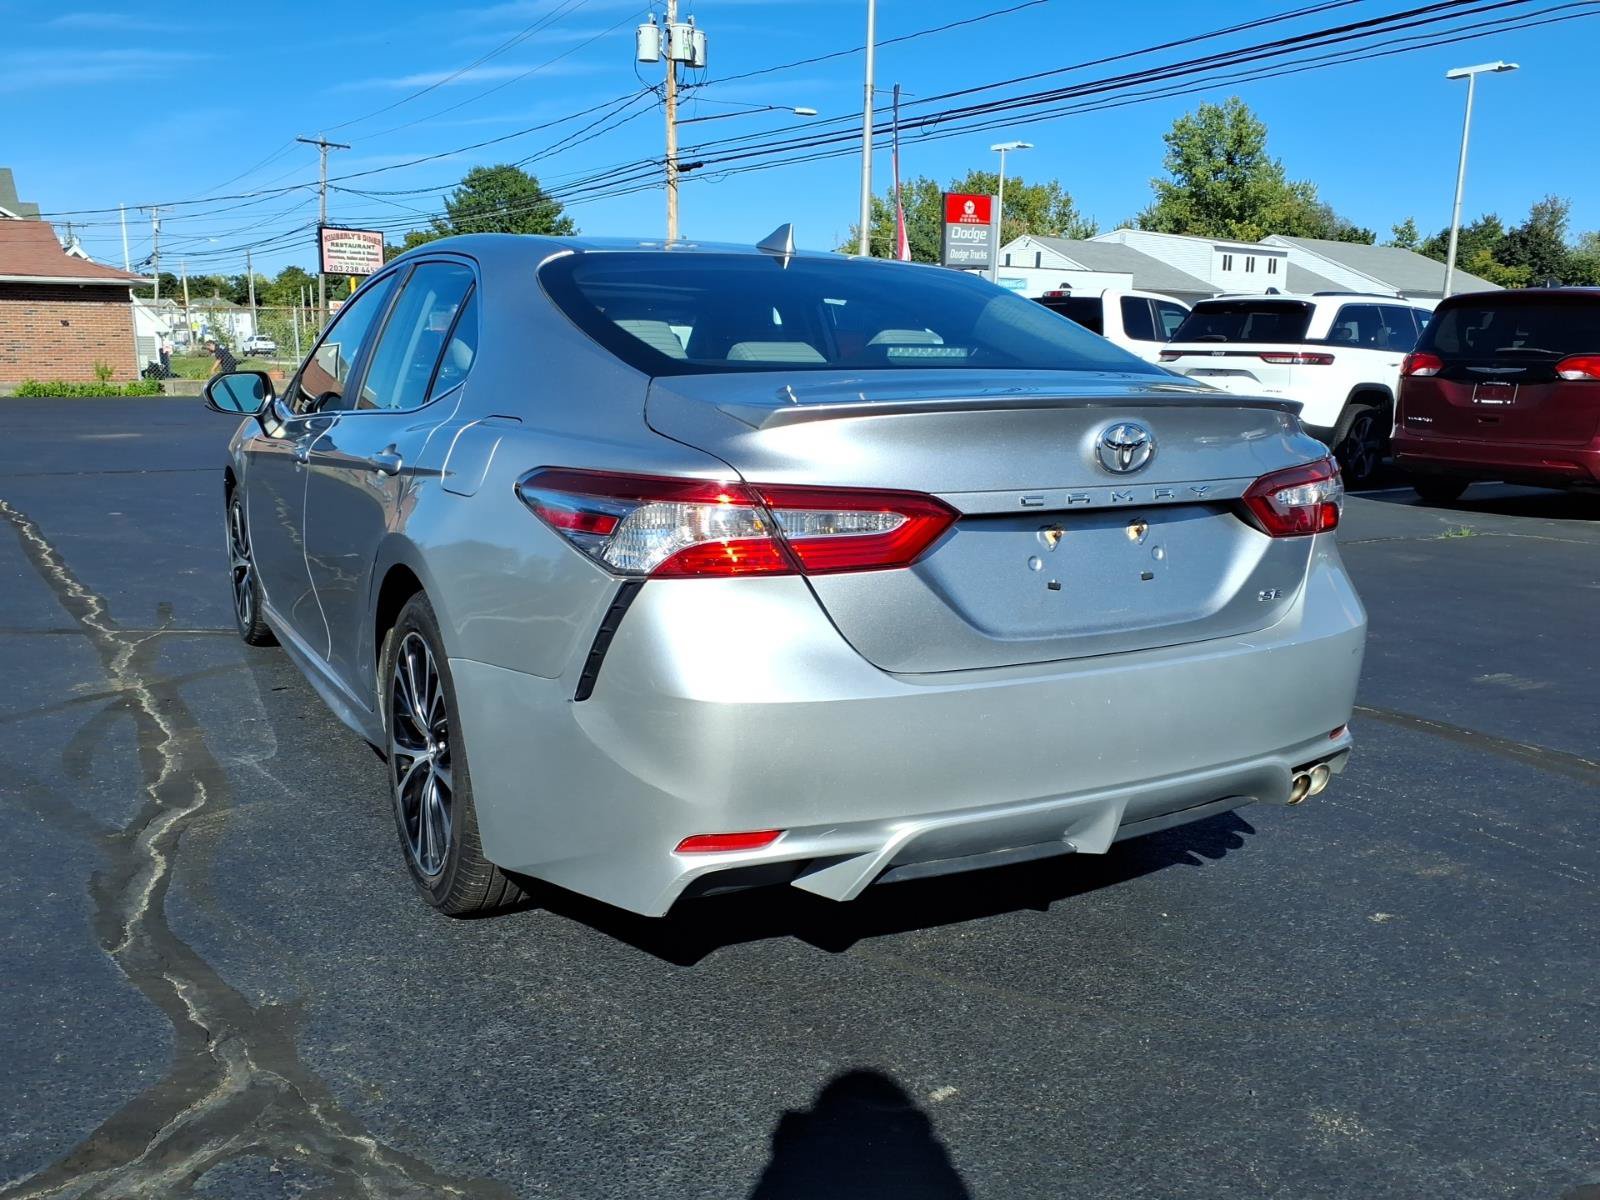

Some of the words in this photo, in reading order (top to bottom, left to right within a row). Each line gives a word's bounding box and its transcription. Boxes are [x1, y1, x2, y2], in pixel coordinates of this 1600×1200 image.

[951, 226, 987, 243] Dodge
[330, 242, 375, 250] RESTAURANT
[949, 248, 969, 261] Dodge
[970, 249, 987, 260] Trucks
[329, 264, 343, 272] 203
[345, 265, 359, 273] 238
[1020, 486, 1208, 506] CAMRY
[1259, 588, 1281, 601] SE
